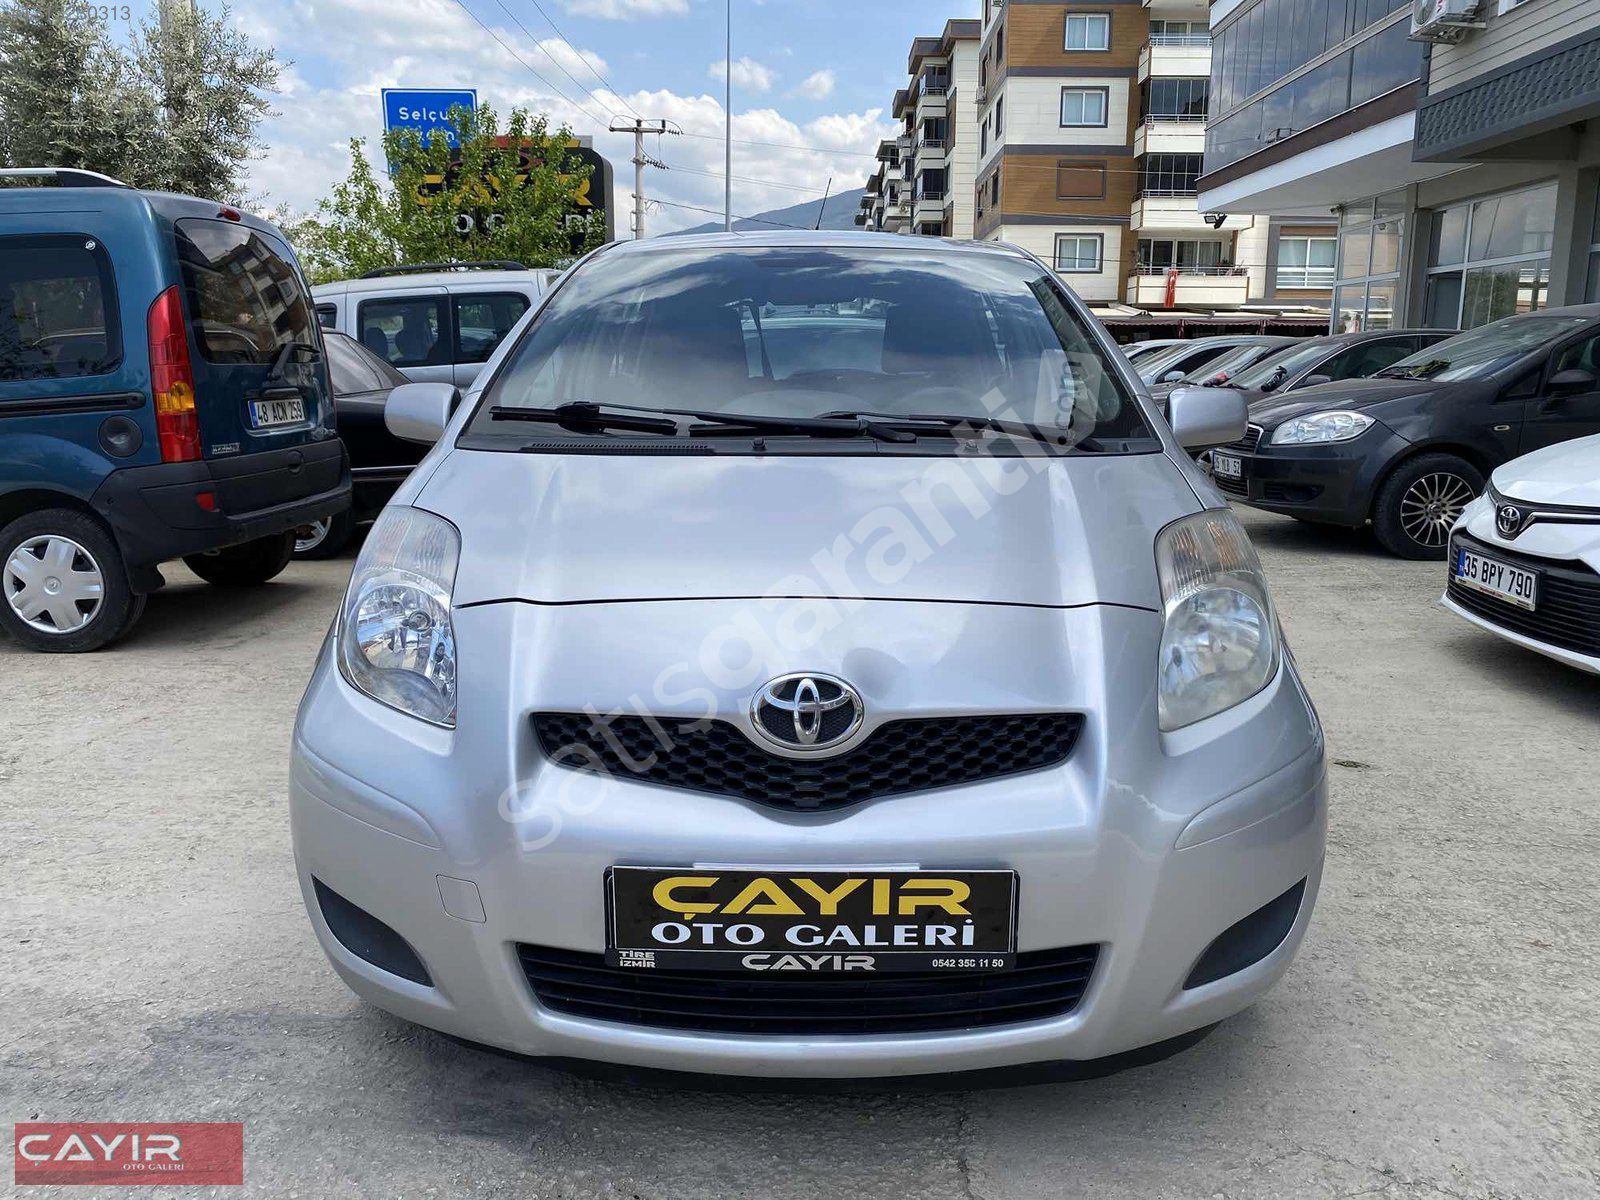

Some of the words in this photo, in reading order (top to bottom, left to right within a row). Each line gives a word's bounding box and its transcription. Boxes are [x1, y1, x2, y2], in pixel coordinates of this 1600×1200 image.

[399, 107, 461, 122] Selçu
[1464, 555, 1478, 578] 35
[1481, 561, 1504, 588] BPY
[1508, 570, 1533, 599] 790
[652, 876, 972, 920] ÇAYIR
[651, 921, 765, 945] OTO
[785, 918, 975, 946] GALERİ
[741, 953, 877, 971] ÇAYIR
[932, 958, 956, 968] 0542
[991, 958, 1004, 968] 50
